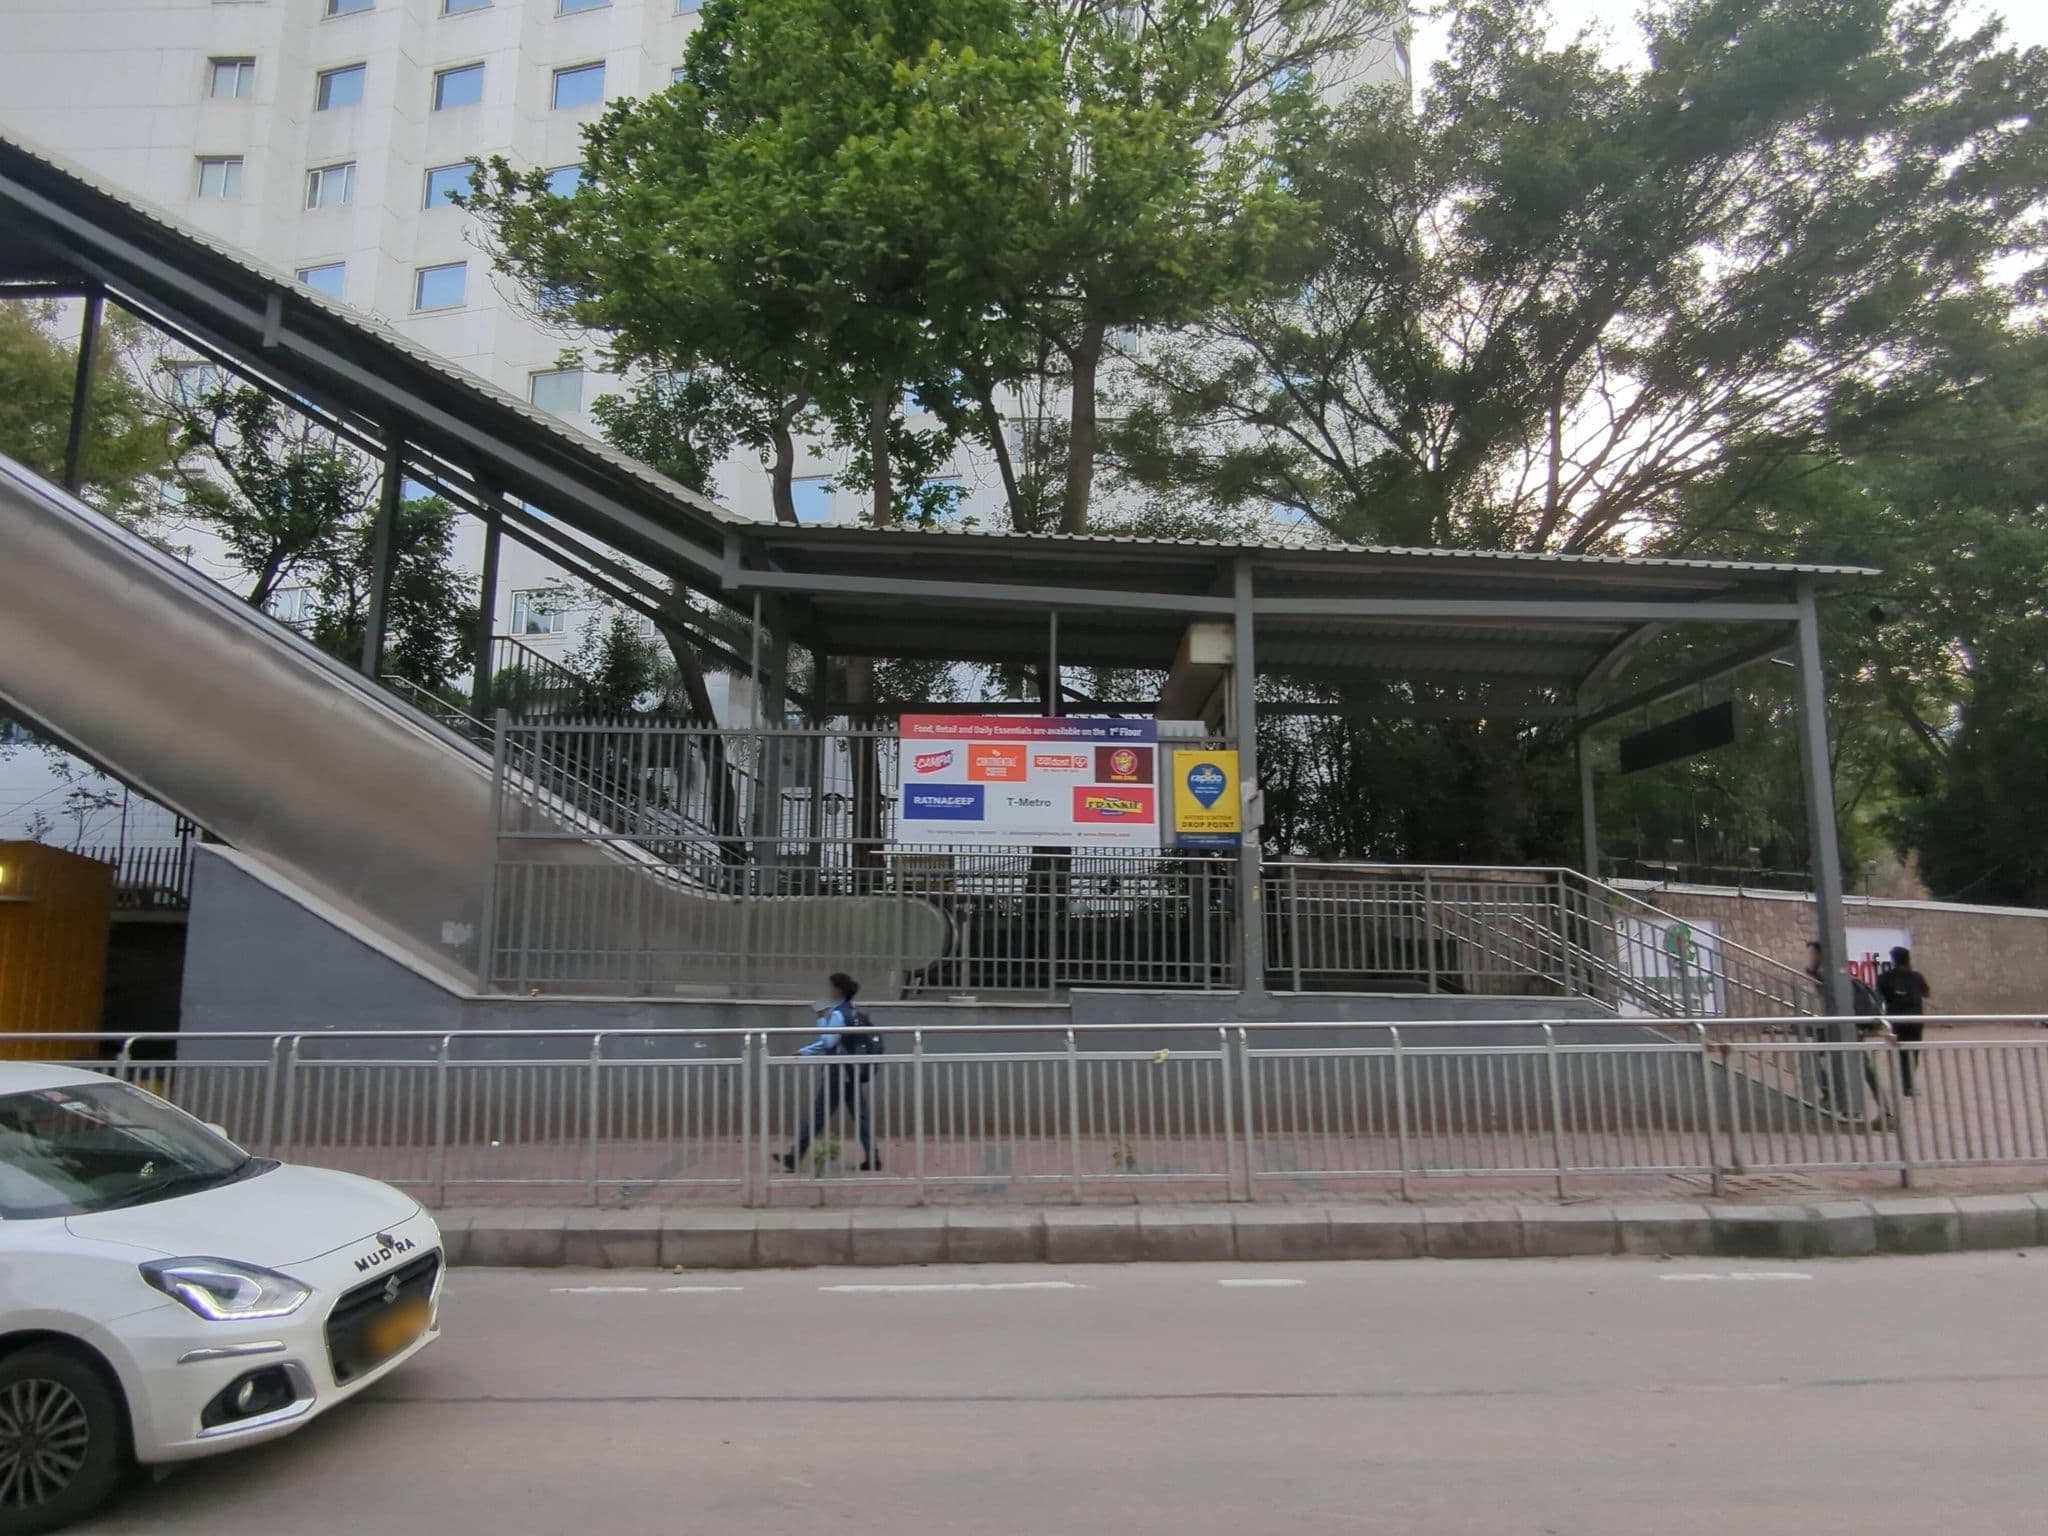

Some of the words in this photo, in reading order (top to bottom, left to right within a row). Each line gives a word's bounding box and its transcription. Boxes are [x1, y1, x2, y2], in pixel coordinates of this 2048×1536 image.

[913, 724, 934, 734] Food,
[958, 725, 973, 734] and
[974, 725, 993, 736] Daily
[994, 726, 1032, 735] Essentials
[1047, 727, 1080, 735] available
[1092, 727, 1106, 736] the
[1119, 727, 1142, 737] Floor
[916, 754, 952, 769] CAMPA
[1191, 774, 1223, 784] rapido
[913, 796, 975, 805] RATNADEEP
[1006, 797, 1052, 807] T-Metro
[353, 1238, 416, 1272] MUDRA
